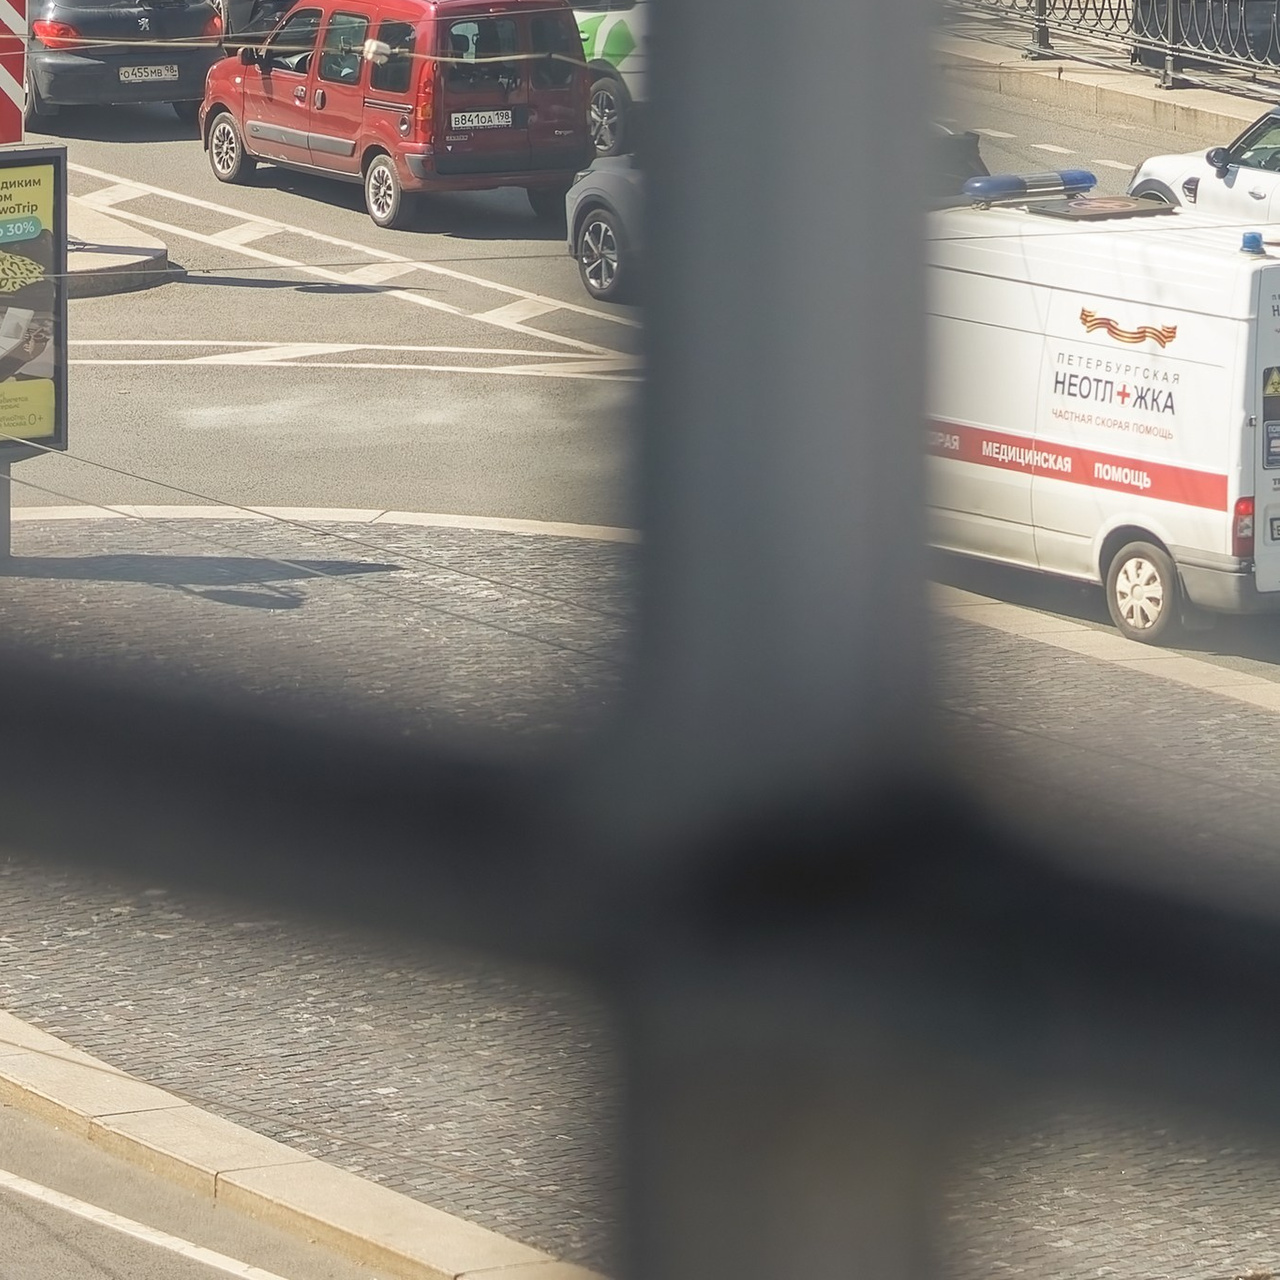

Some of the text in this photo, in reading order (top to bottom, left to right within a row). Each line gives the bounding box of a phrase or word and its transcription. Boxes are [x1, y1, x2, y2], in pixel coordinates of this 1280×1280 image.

[454, 111, 510, 126] В841ОА 198
[0, 177, 41, 191] диким
[6, 220, 36, 237] 30%
[1056, 352, 1180, 384] ПЕТЕРБУРГСКАЯ
[28, 413, 44, 426] 0+
[1051, 407, 1174, 440] ЧАСТНАЯ СКОРАЯ ПОМОЩЬ
[982, 440, 1072, 474] МЕДИЦИНСКАЯ
[1093, 461, 1152, 490] ПОМОЩЬ
